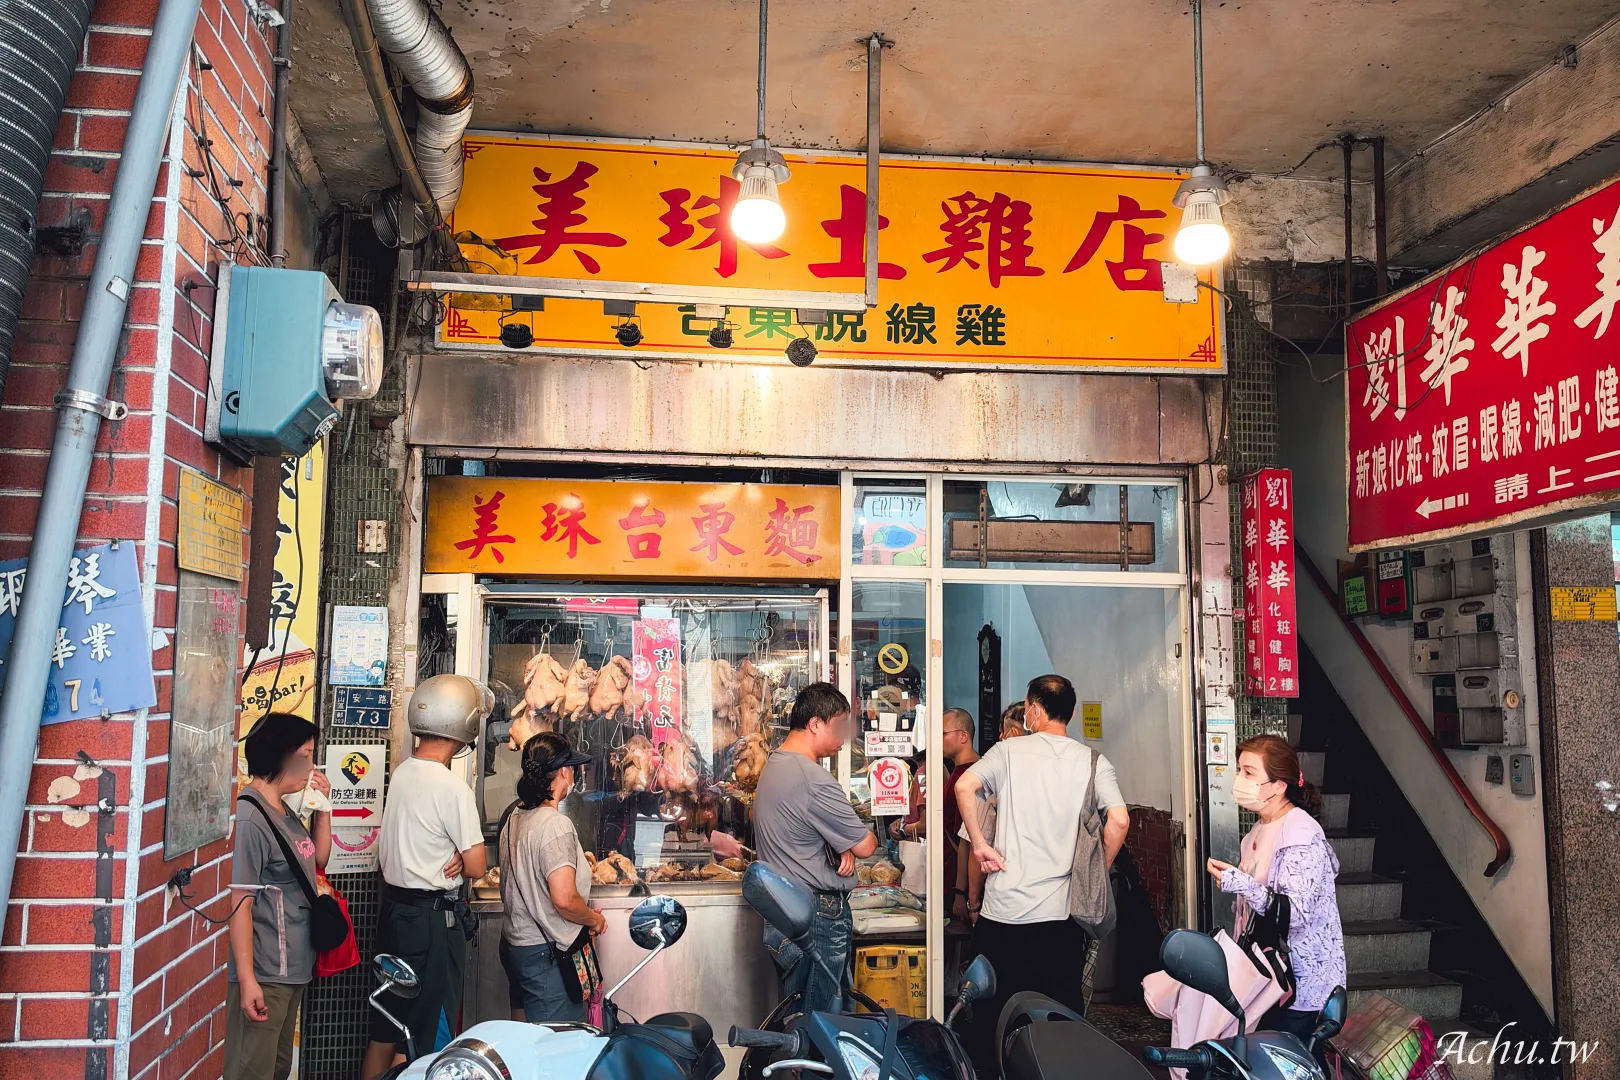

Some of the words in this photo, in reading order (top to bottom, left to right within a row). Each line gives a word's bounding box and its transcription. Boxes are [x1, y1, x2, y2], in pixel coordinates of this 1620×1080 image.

[495, 161, 1167, 291] 美珠土雞店
[454, 489, 822, 566] 美珠台東麵
[1243, 477, 1260, 596] 劉華華
[1265, 476, 1291, 596] 劉華華
[1268, 600, 1292, 673] 化粧健胸
[352, 693, 387, 704] 安一路
[356, 709, 380, 725] 73
[1269, 676, 1294, 692] 2樓
[331, 788, 377, 800] 防空避難
